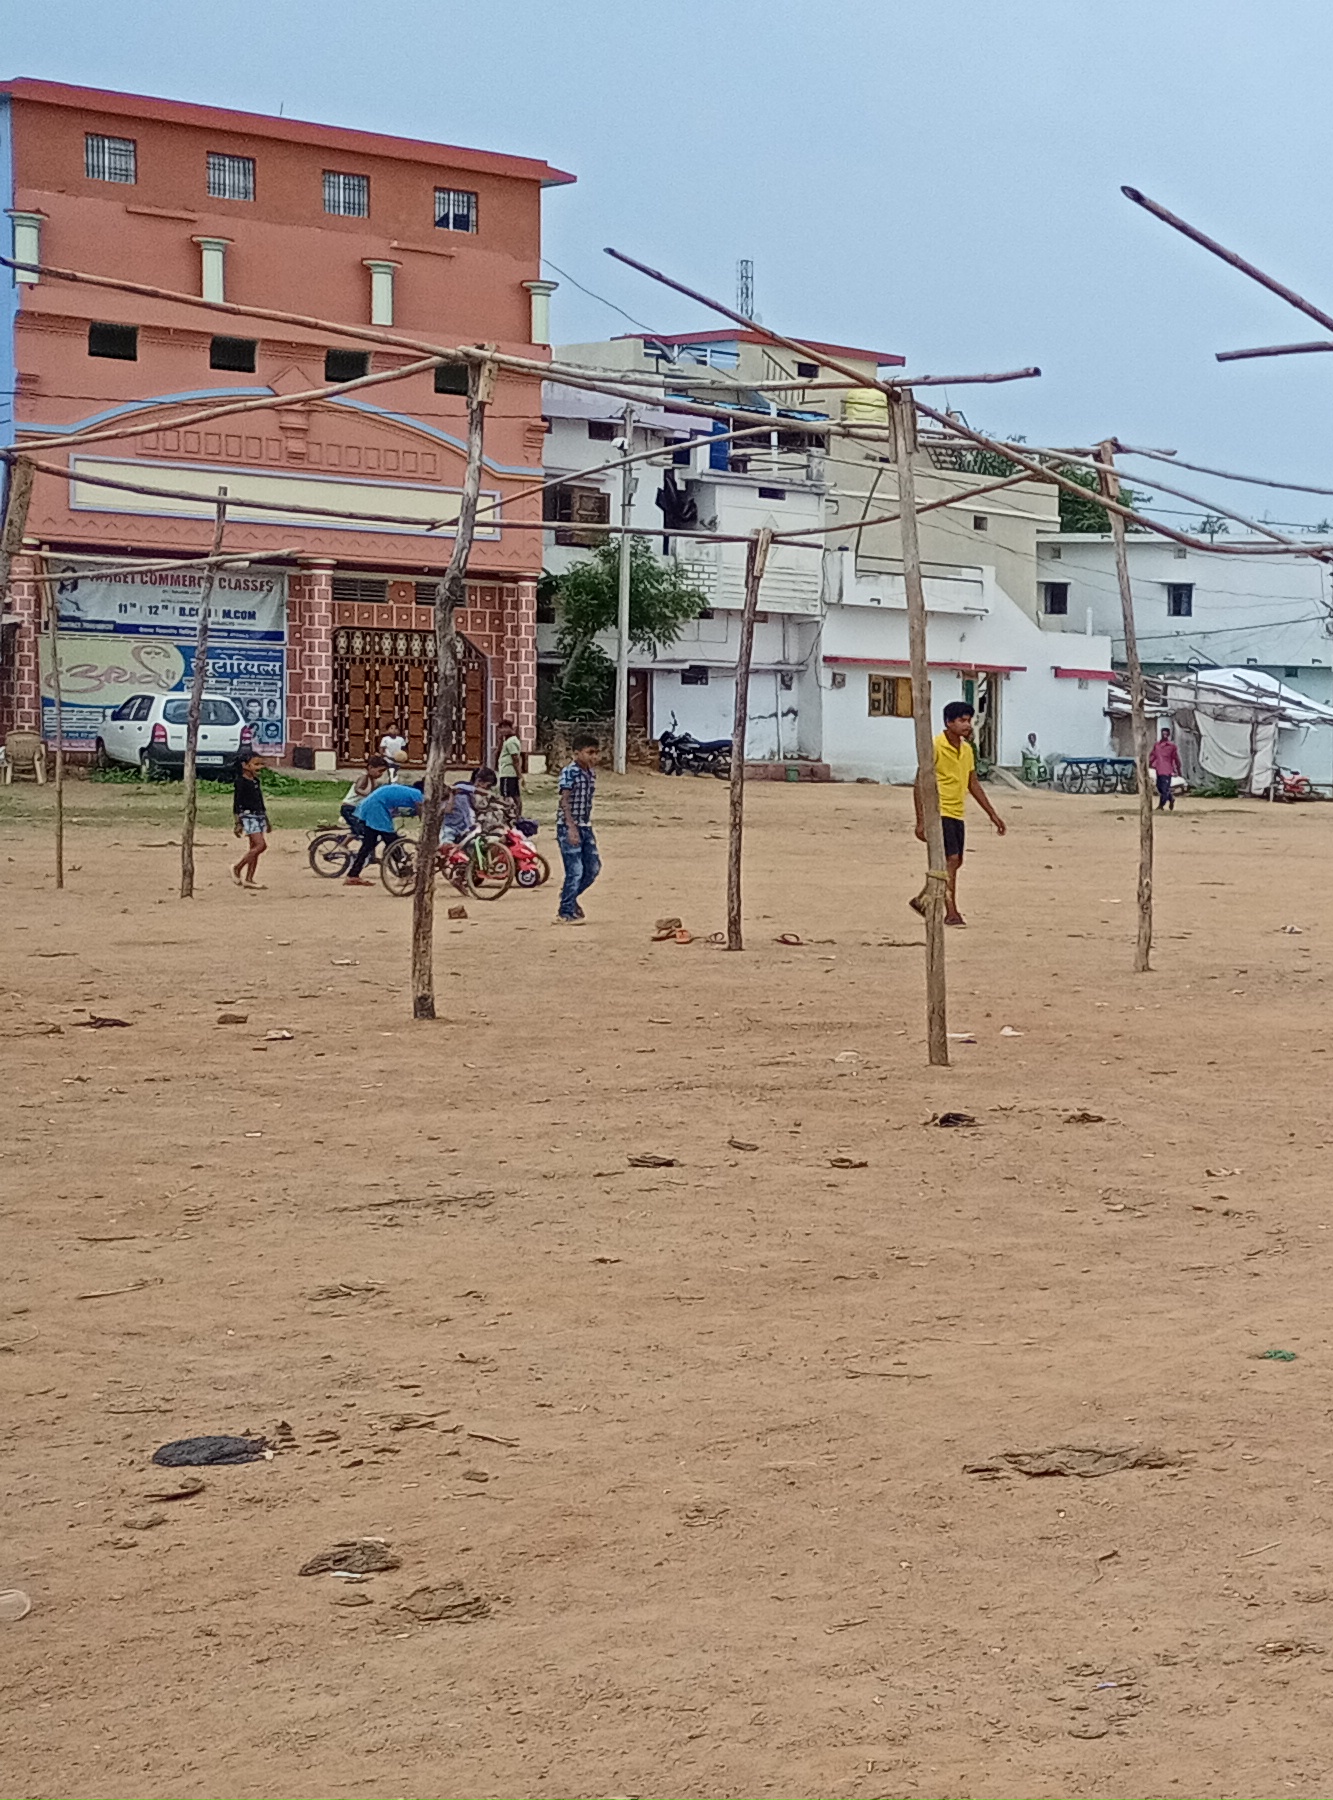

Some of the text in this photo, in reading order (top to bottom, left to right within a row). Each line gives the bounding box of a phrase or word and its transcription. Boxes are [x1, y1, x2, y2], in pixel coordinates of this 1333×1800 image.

[140, 572, 207, 589] COMMERC
[218, 576, 275, 592] CLASSES
[221, 609, 258, 621] M.COM
